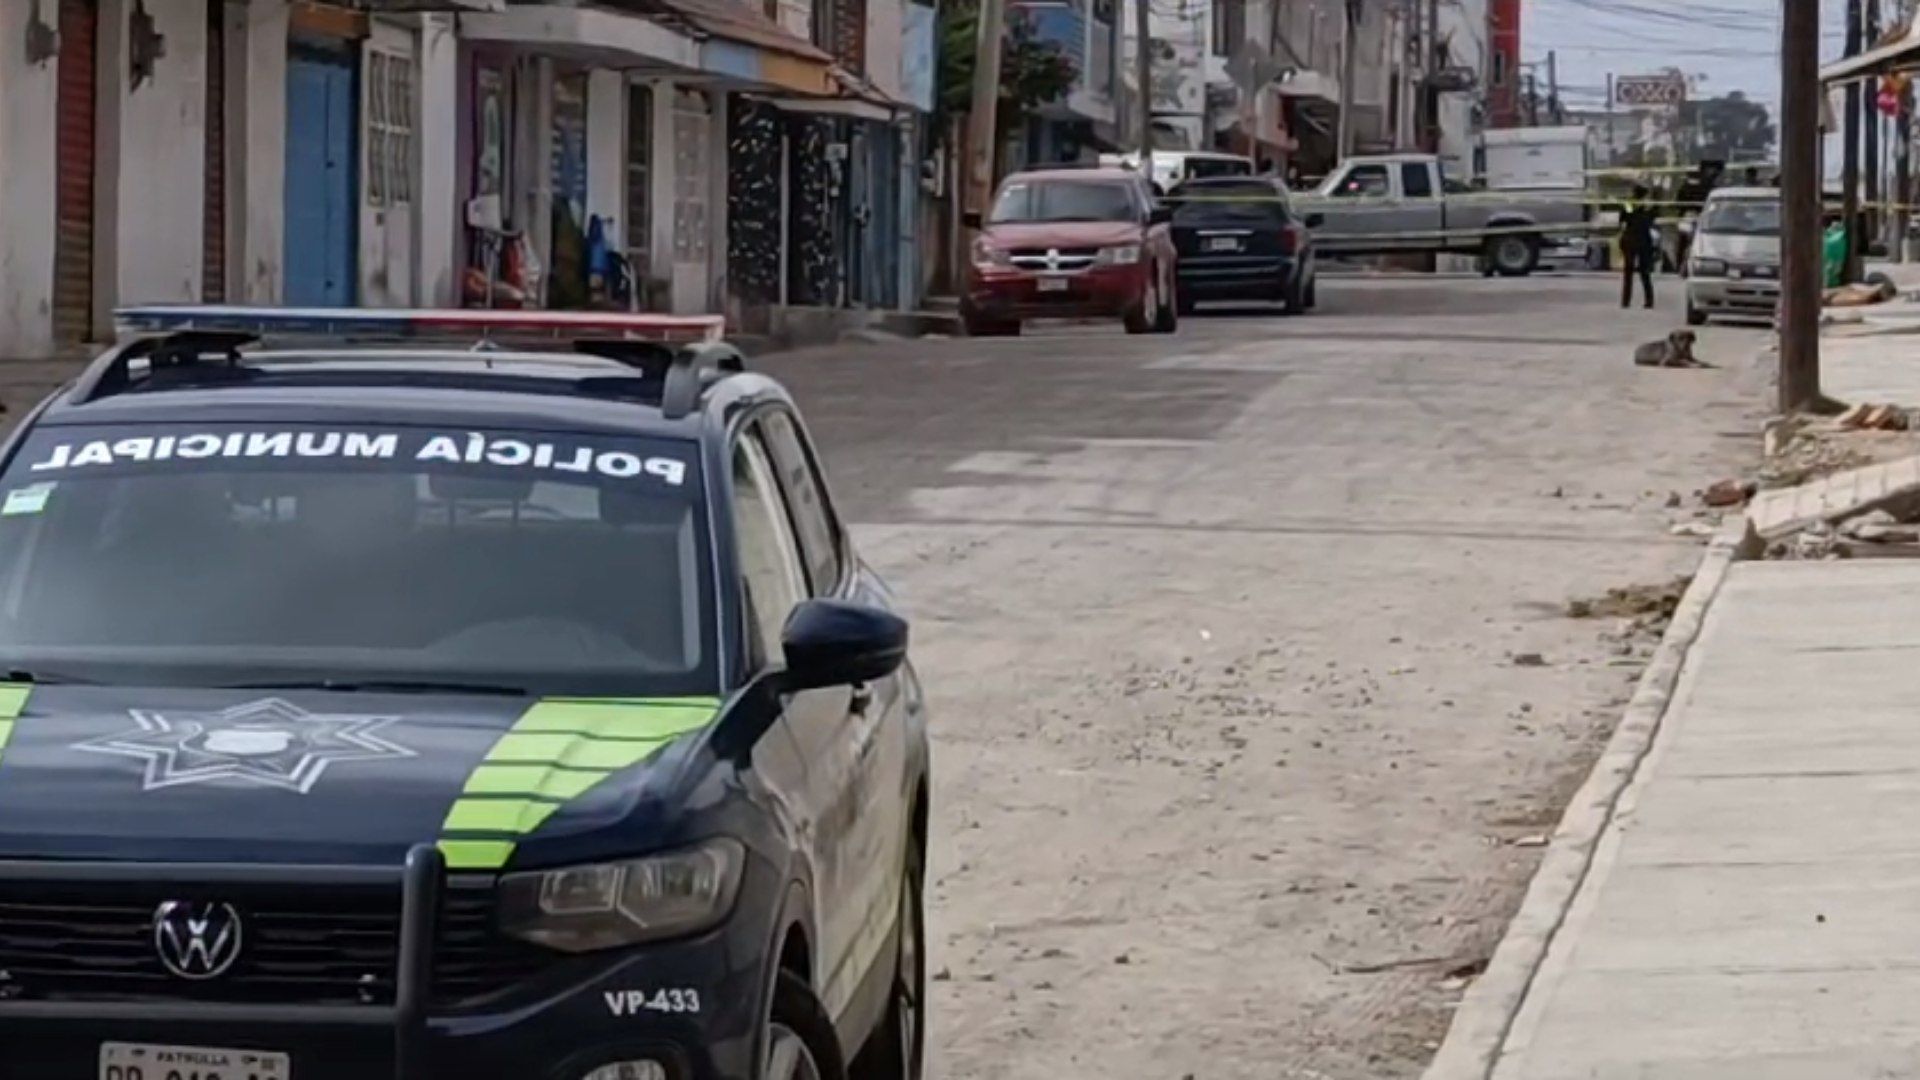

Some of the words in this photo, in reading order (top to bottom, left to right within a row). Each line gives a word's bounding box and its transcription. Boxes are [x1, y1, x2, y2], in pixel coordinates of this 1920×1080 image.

[1618, 82, 1682, 103] OXXO
[604, 988, 700, 1016] VP-433
[156, 1052, 230, 1067] PATRULLA
